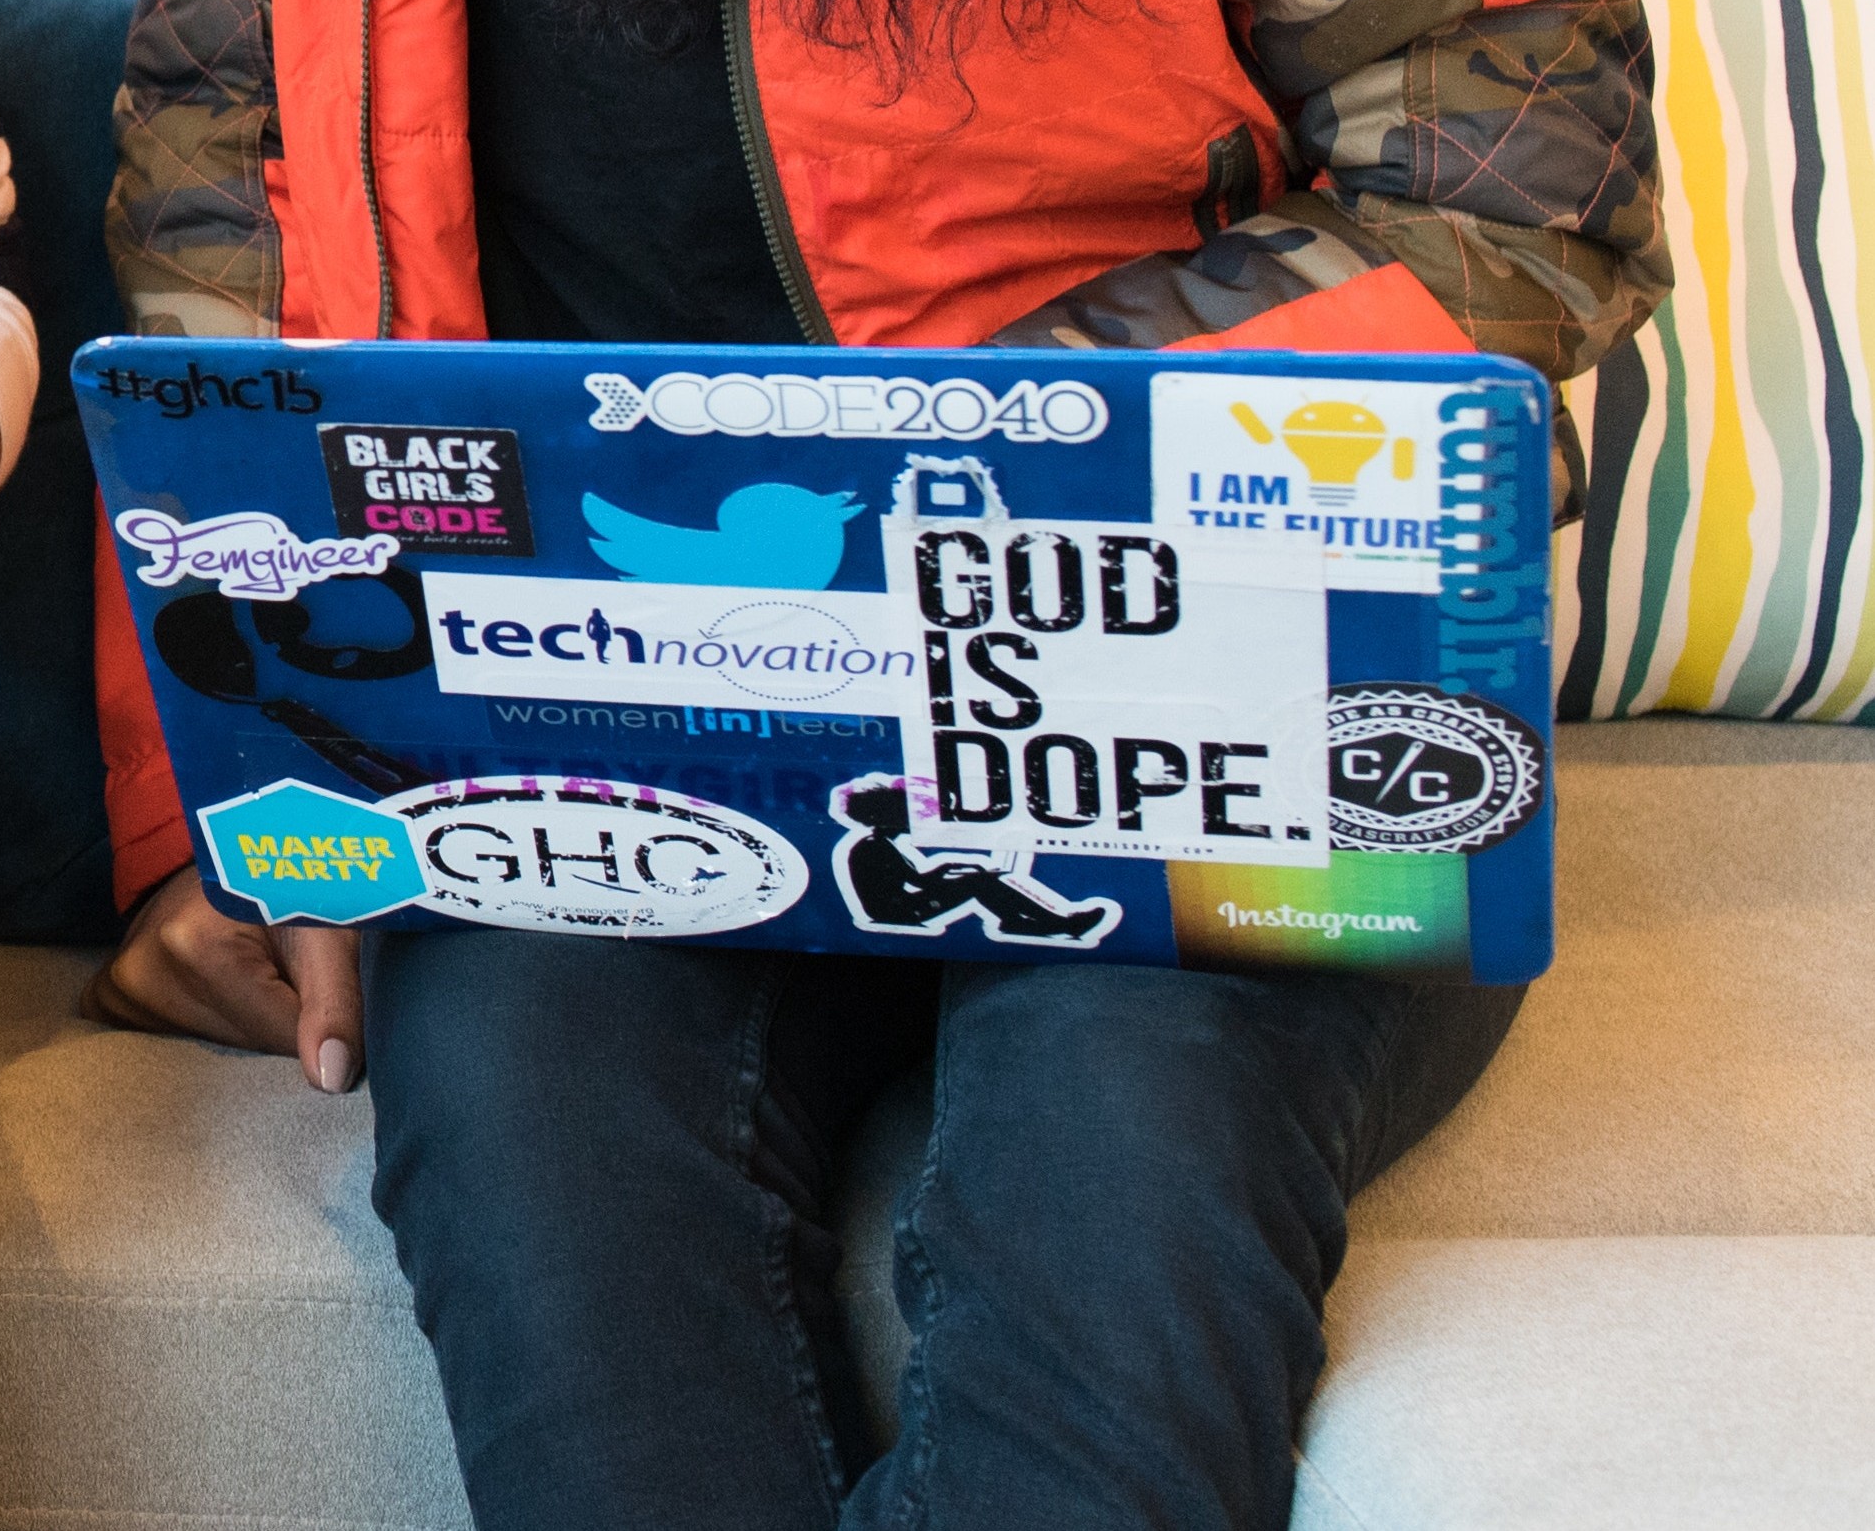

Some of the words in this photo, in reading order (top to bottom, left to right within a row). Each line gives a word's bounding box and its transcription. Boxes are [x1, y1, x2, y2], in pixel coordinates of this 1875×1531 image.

[651, 378, 1098, 437] CODE2040
[344, 433, 501, 471] BLACK
[364, 469, 495, 503] GIRLS
[1189, 472, 1201, 502] I
[1218, 474, 1289, 505] AM
[364, 504, 508, 535] CODE
[125, 516, 389, 592] Femgineer
[914, 531, 1180, 635] GOD
[438, 607, 915, 677] technovation
[923, 629, 1042, 731] IS
[1410, 707, 1488, 741] CRAFT
[933, 729, 1311, 841] DOPE.
[237, 834, 395, 860] MAKER
[425, 822, 721, 897] GHC
[246, 857, 384, 881] PARTY
[1217, 901, 1423, 939] Instagram
